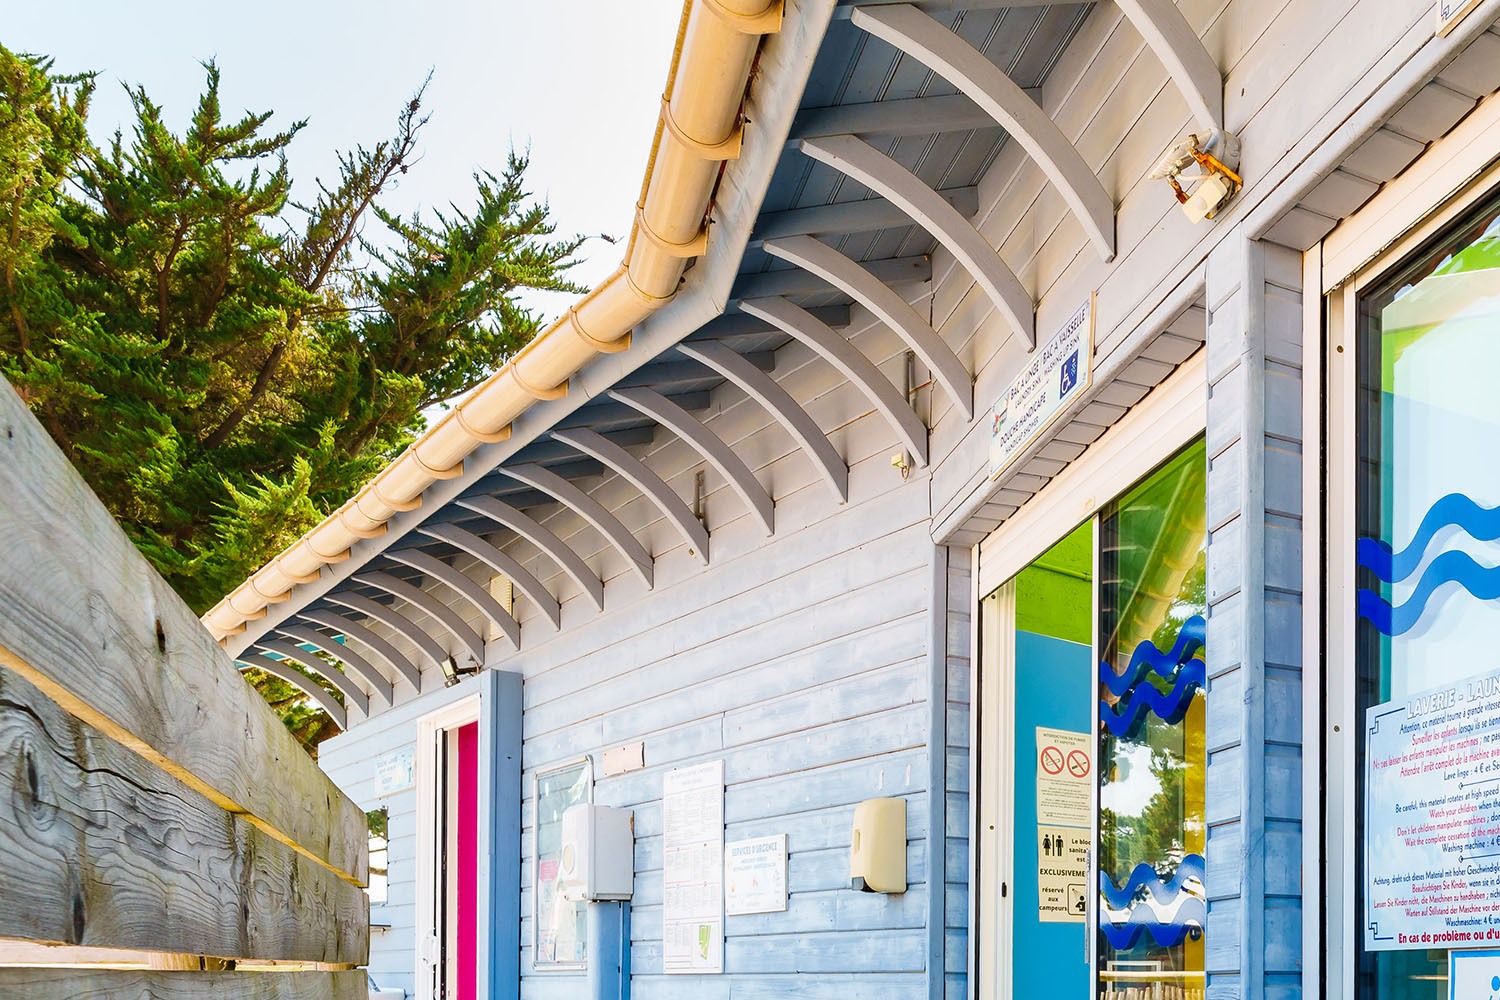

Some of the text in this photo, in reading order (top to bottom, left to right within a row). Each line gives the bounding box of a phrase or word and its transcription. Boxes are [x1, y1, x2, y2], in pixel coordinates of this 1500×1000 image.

[1407, 688, 1455, 718] LAVERIE
[1040, 868, 1086, 877] EXCLUSIVEME
[1398, 933, 1408, 943] En
[1421, 932, 1430, 942] de
[1433, 930, 1471, 944] problème
